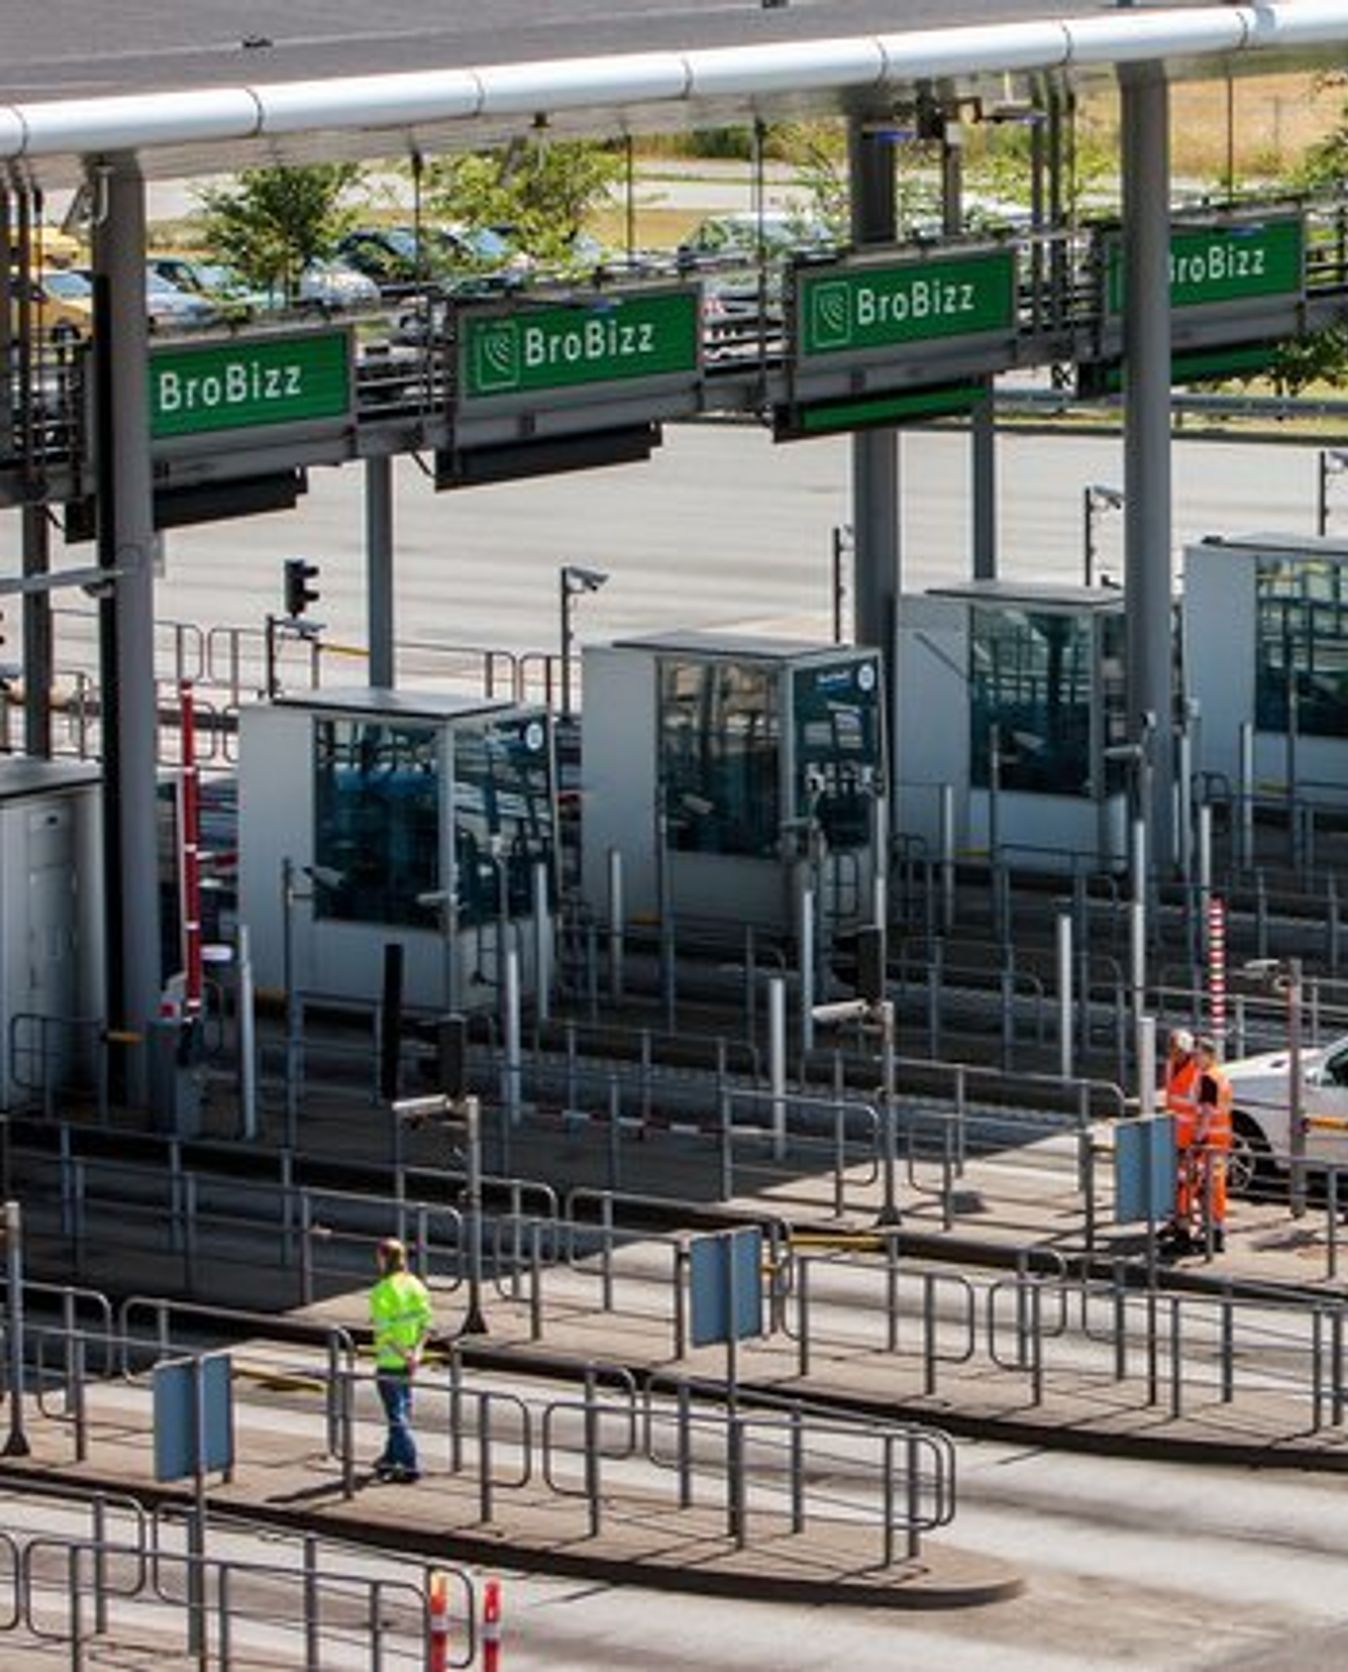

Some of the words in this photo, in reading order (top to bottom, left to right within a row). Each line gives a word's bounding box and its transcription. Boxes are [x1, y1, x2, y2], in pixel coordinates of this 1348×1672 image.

[857, 279, 975, 325] BroBizz
[525, 319, 654, 367] BroBizz
[160, 361, 301, 410] BroBizz
